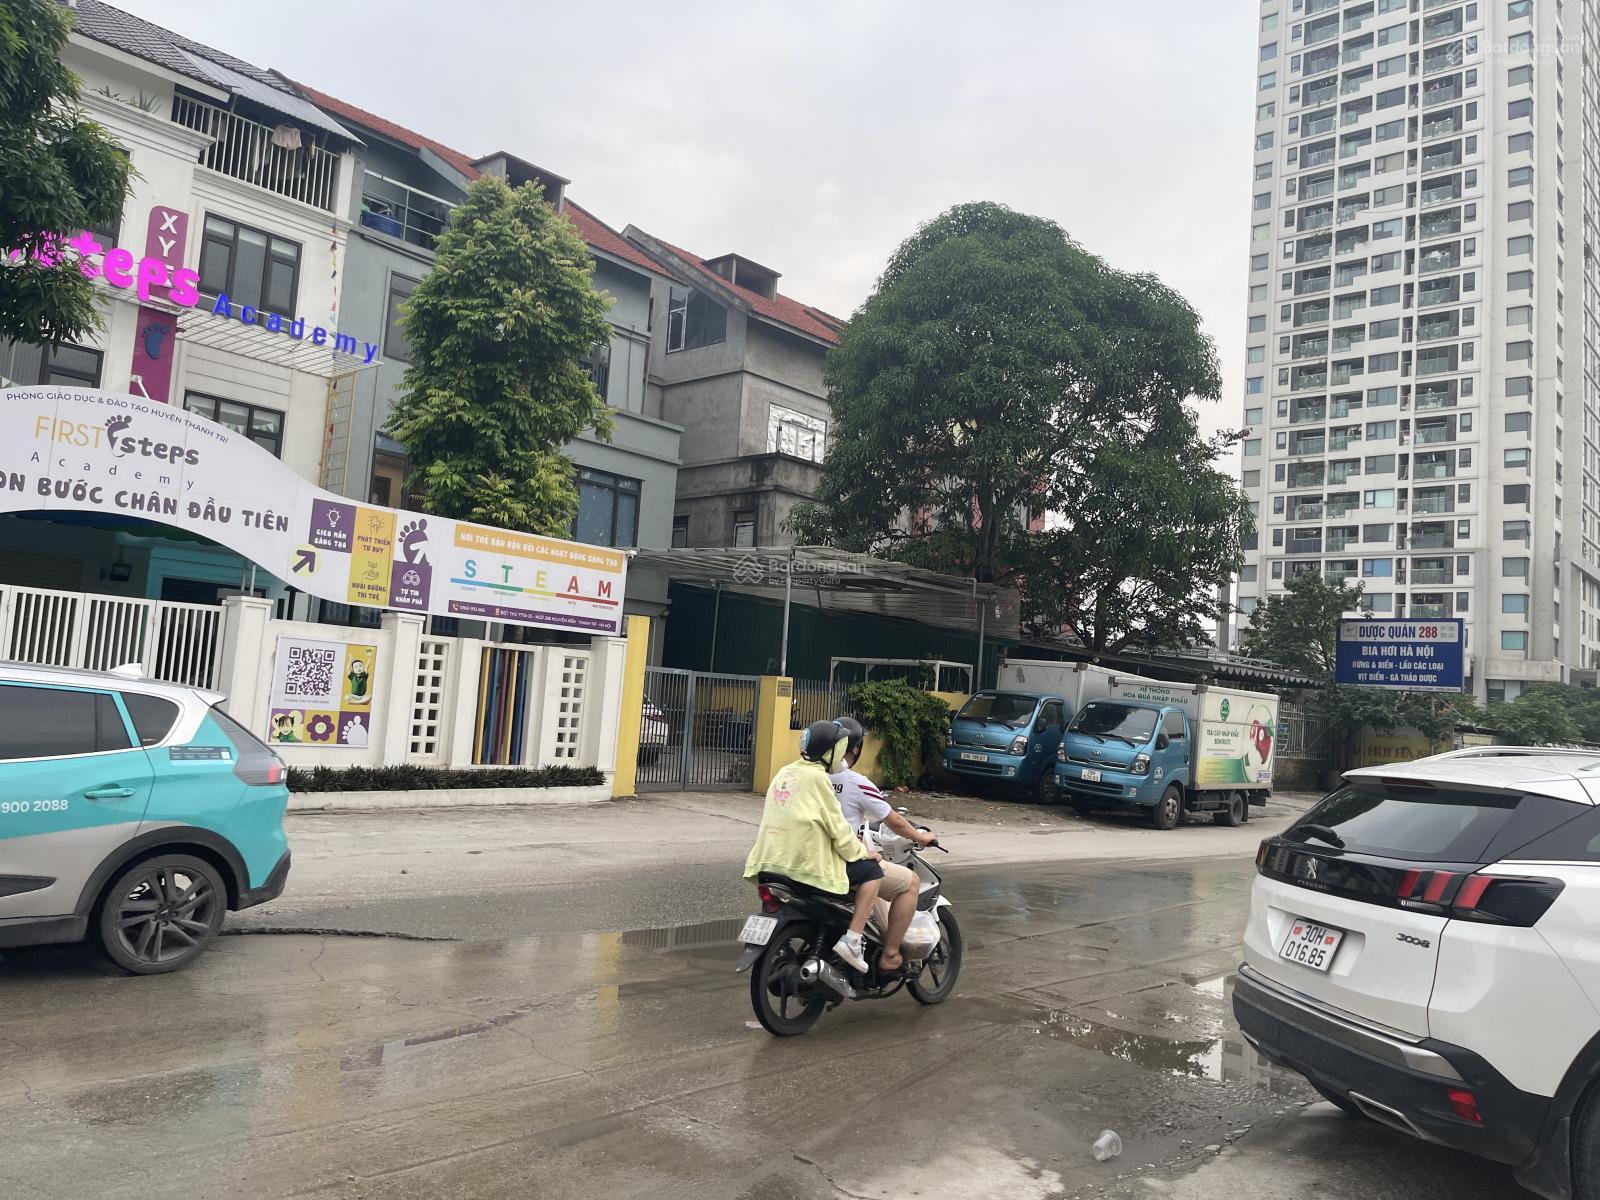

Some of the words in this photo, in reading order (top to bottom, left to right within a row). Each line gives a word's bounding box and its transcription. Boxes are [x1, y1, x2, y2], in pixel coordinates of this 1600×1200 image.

[212, 293, 378, 364] Academy
[7, 392, 44, 400] PHÒNG
[47, 392, 72, 400] GIÁO
[107, 398, 128, 408] ĐÀO
[151, 408, 182, 424] HUYỆN
[185, 419, 214, 437] THANH
[216, 433, 229, 444] TRÌ
[34, 415, 105, 449] FIRST
[120, 436, 200, 465] steps
[31, 451, 194, 490] Academy
[37, 477, 104, 504] BƯỚC
[114, 490, 178, 515] CHÂN
[187, 496, 232, 523] ĐẦU
[242, 508, 289, 532] TIÊN
[1359, 625, 1385, 640] DƯỢC
[1418, 626, 1438, 639] 288
[1362, 646, 1378, 656] BIA
[1380, 645, 1397, 656] HƠI
[1400, 644, 1413, 656] HÀ
[1416, 645, 1434, 659] NỘI
[1352, 660, 1370, 669] RỪNG
[1413, 661, 1427, 670] CÁC
[1428, 662, 1444, 671] LOẠI
[1358, 673, 1368, 682] VỊT
[1390, 672, 1399, 681] GÀ
[33, 799, 68, 812] 2088
[1301, 925, 1327, 946] 30H
[1396, 932, 1431, 948] 3008
[1285, 940, 1327, 967] 016.85
